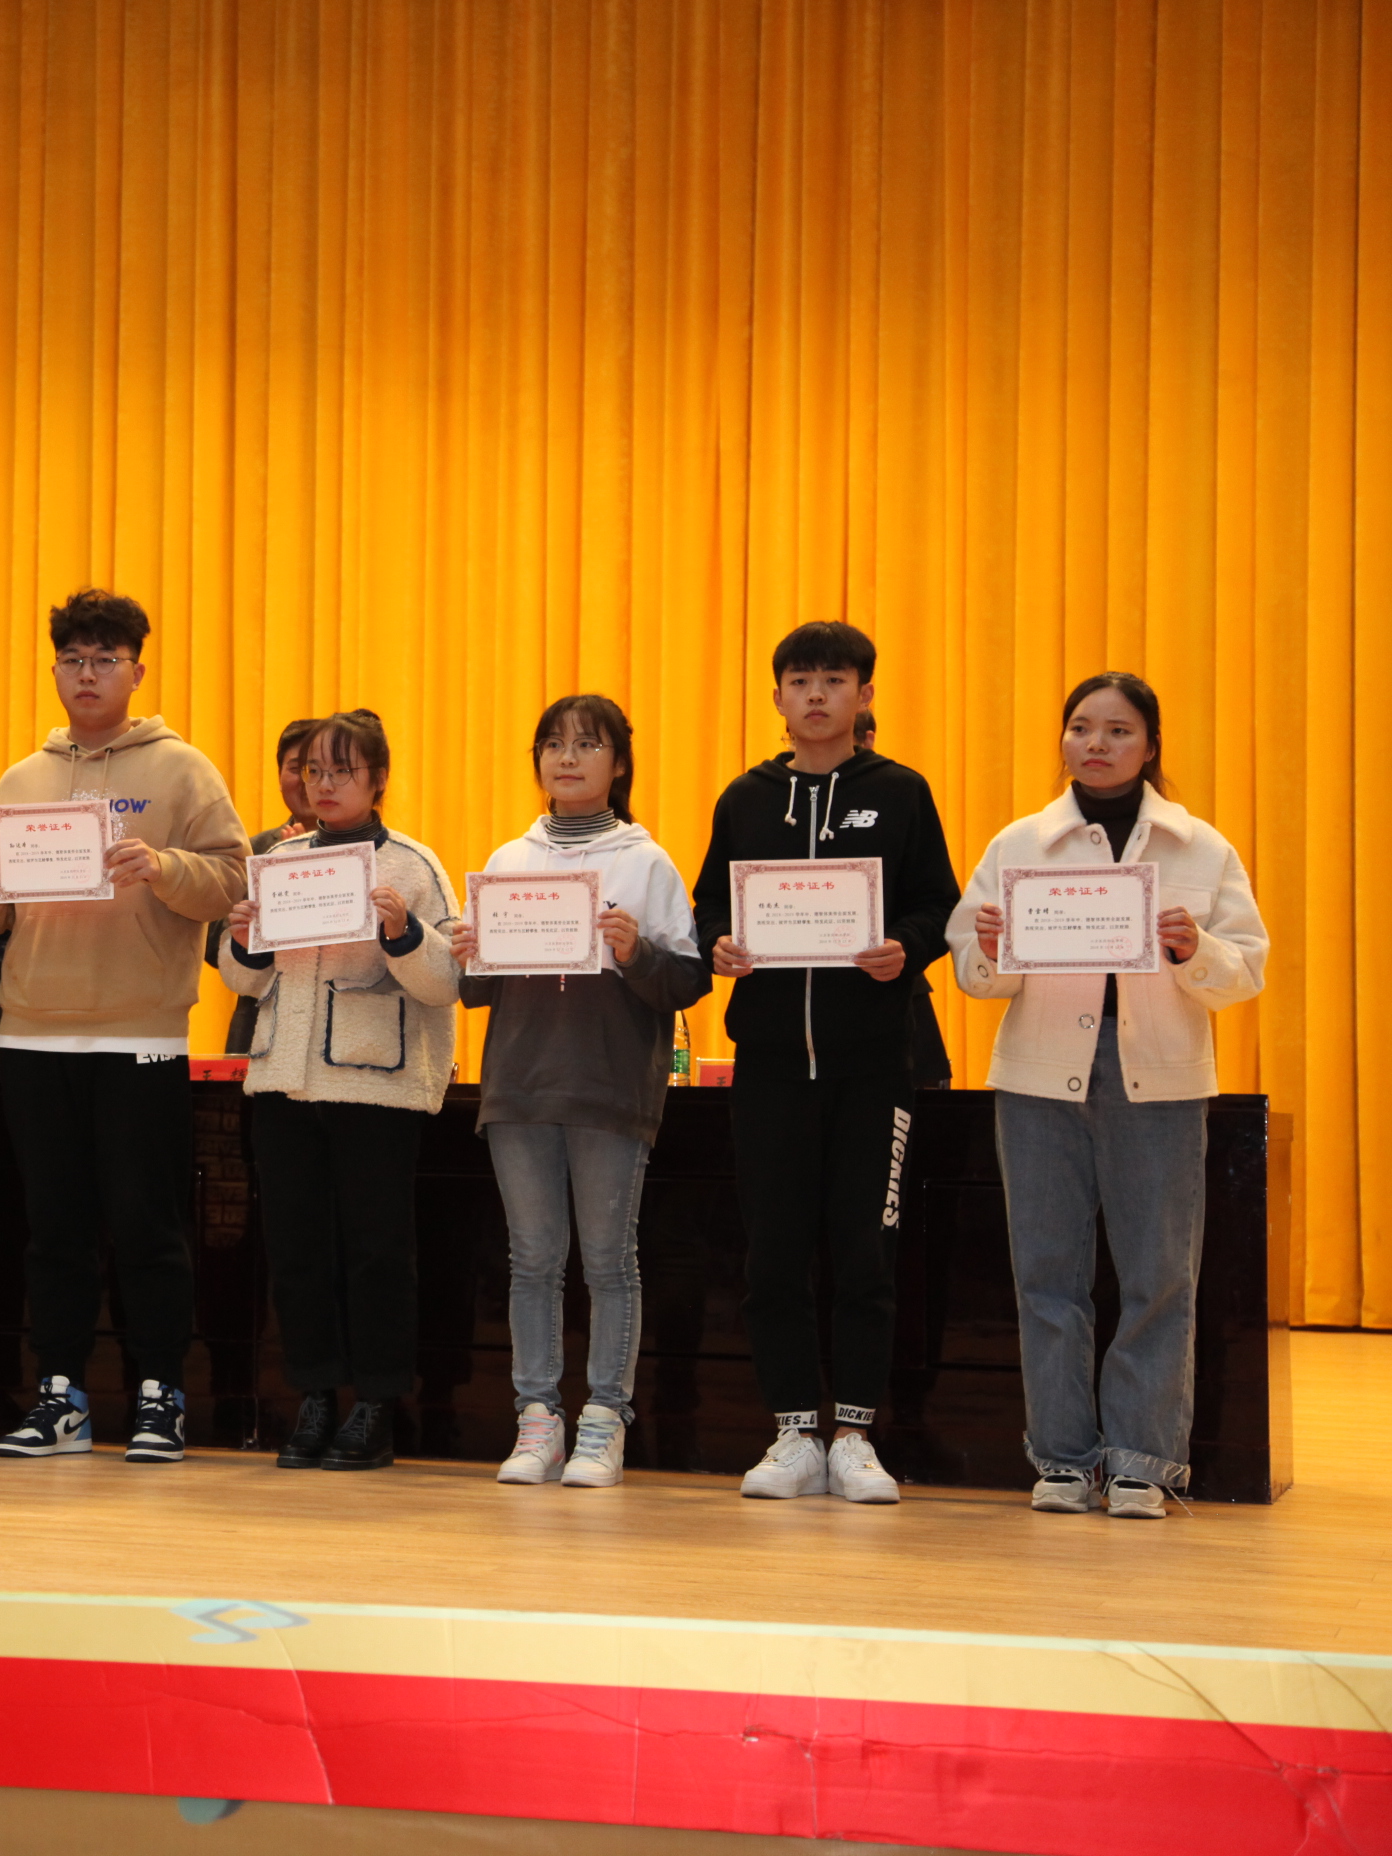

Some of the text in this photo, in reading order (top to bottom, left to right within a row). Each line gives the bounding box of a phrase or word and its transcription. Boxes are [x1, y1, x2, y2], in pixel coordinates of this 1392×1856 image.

[839, 809, 879, 828] NB
[25, 823, 73, 832] 荣誉证书
[288, 868, 337, 880] 荣誉证书
[778, 881, 836, 891] 荣誉证书
[1048, 886, 1109, 896] 荣誉证书
[508, 892, 560, 901] 荣誉证书
[882, 1106, 912, 1226] DICKIES
